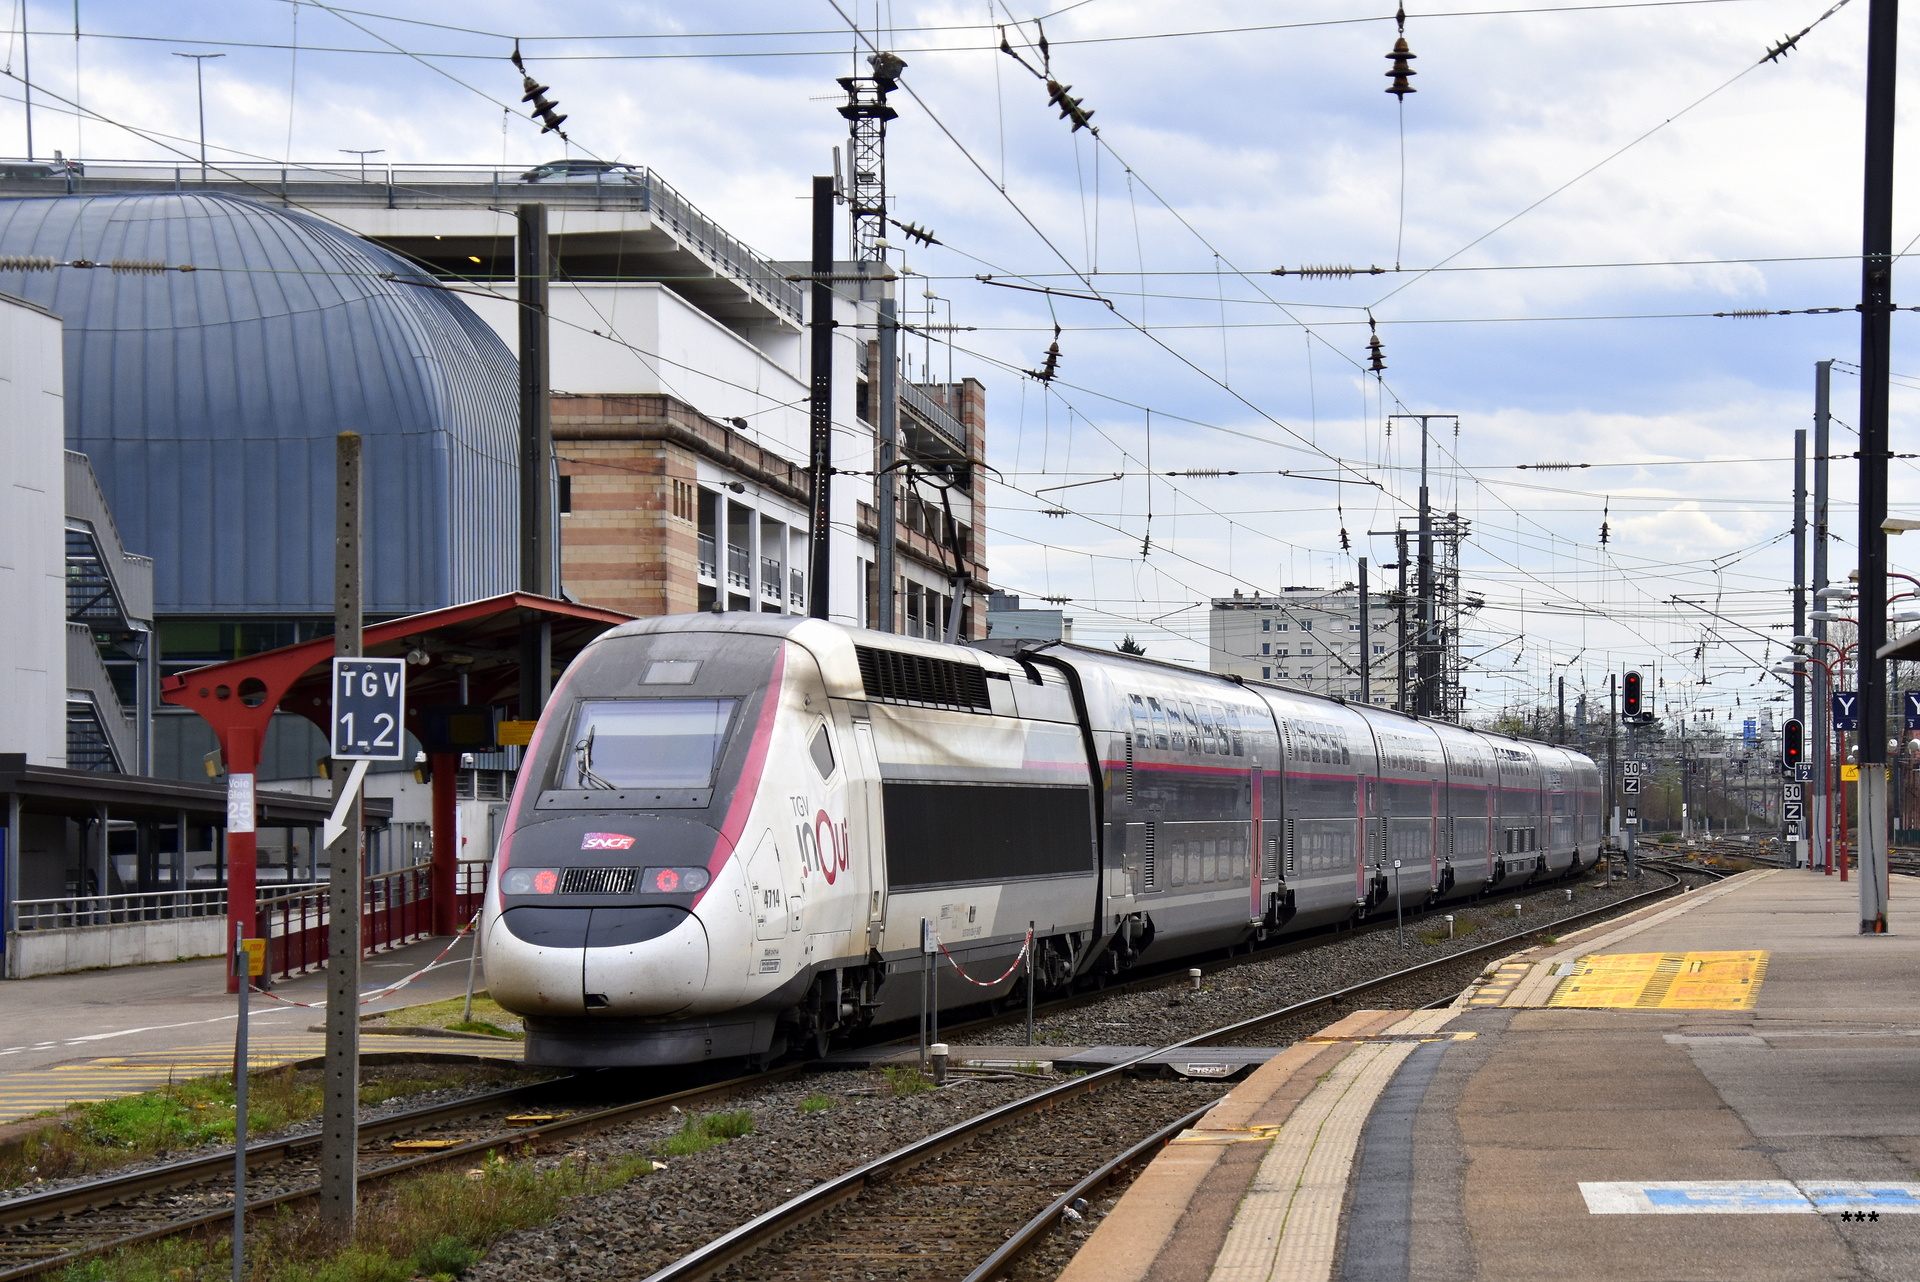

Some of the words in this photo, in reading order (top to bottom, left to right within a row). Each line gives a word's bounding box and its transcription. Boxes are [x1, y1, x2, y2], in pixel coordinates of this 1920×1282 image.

[340, 671, 399, 697] TGV
[1838, 697, 1855, 716] Y
[1625, 762, 1638, 774] 30
[1802, 770, 1809, 780] 2
[228, 779, 250, 788] Voie
[1625, 780, 1637, 792] Z
[228, 789, 251, 799] Gleis
[1785, 786, 1800, 798] 30
[228, 802, 251, 819] 25
[790, 796, 809, 817] TGV
[1786, 805, 1799, 818] Z
[583, 838, 632, 848] SNCF
[764, 888, 780, 909] 4714
